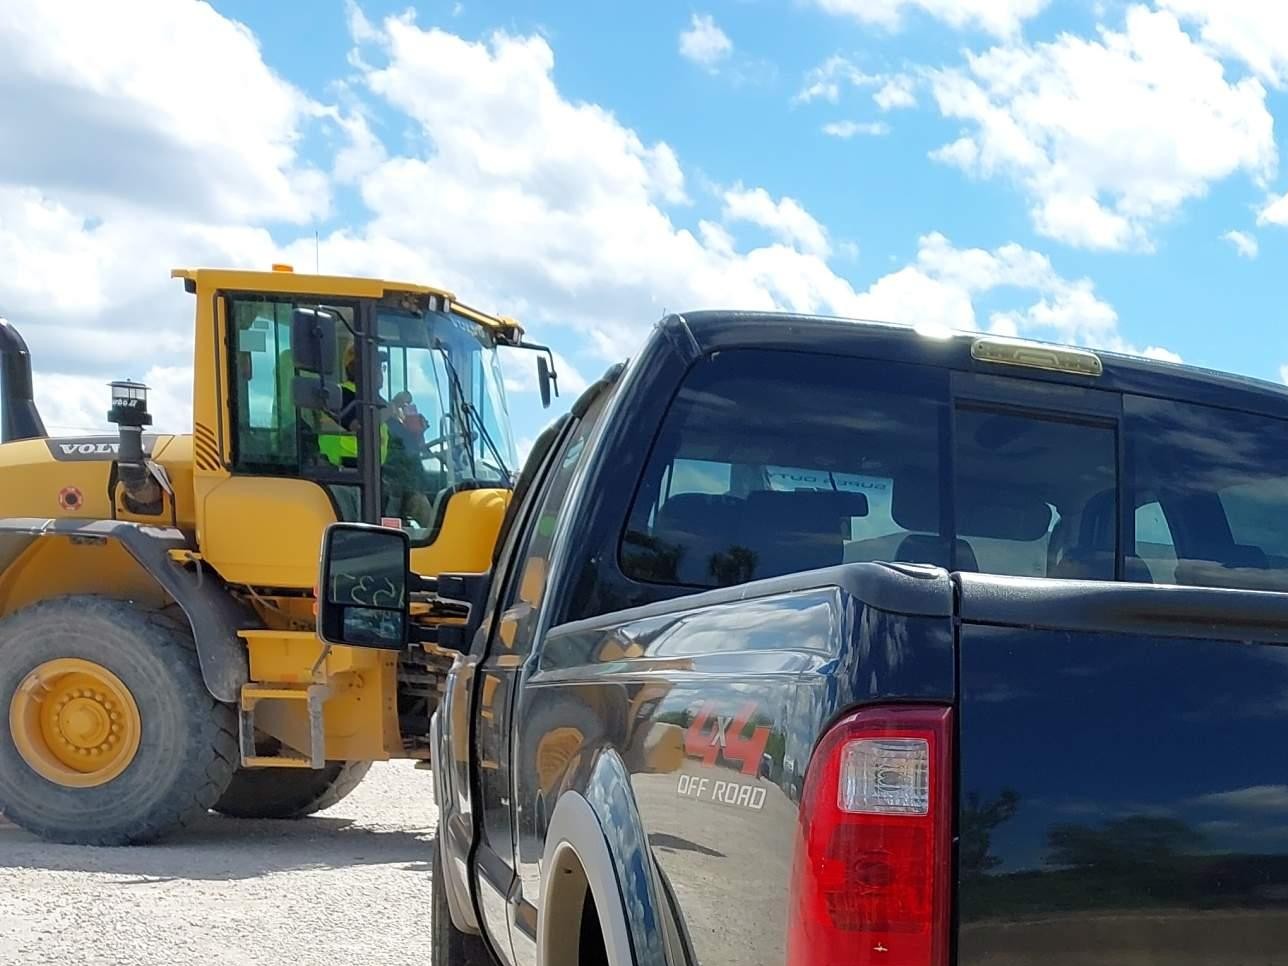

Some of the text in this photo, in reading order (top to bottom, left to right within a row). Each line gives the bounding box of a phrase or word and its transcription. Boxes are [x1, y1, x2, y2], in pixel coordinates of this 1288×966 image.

[60, 443, 121, 454] VOLV
[678, 775, 766, 809] OFF ROAD
